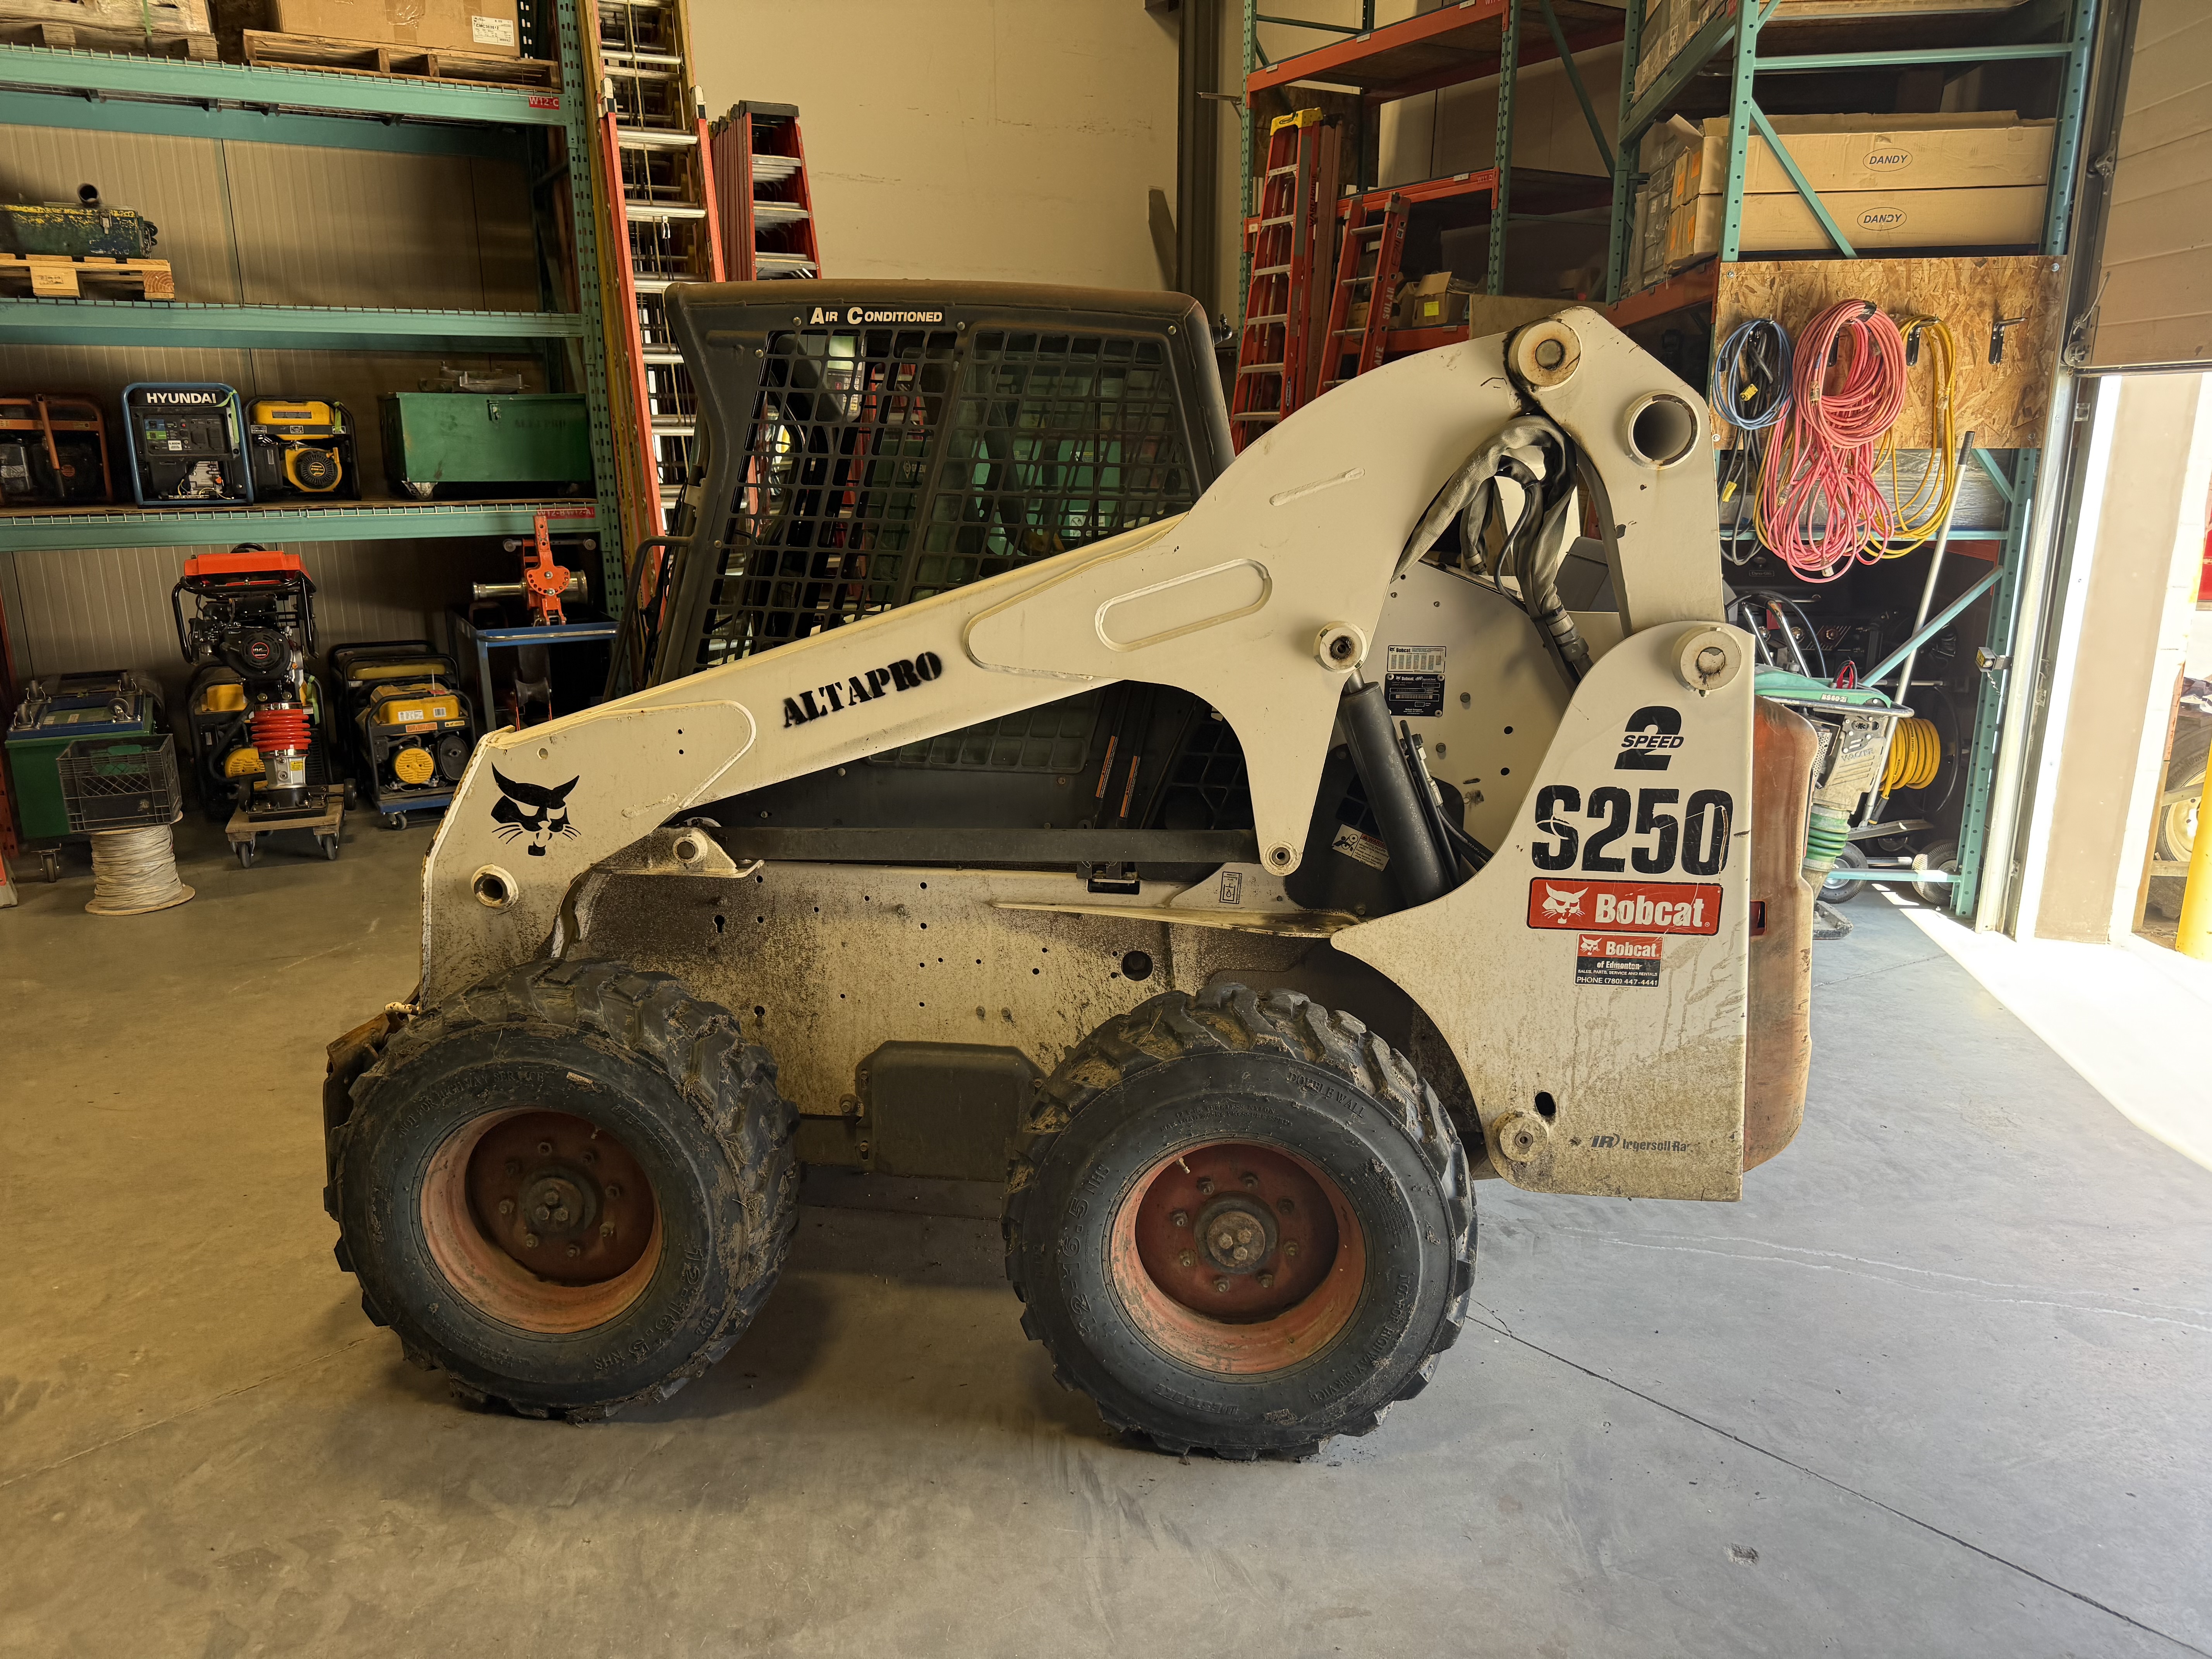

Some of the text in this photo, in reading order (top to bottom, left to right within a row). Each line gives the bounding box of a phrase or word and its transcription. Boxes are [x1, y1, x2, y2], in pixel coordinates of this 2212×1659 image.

[529, 97, 559, 106] W12-C
[1869, 155, 1908, 164] DANDY
[1863, 214, 1902, 223] DANDY
[1382, 287, 1394, 320] SOLAR
[810, 307, 943, 325] AIR CONDITIONED
[146, 393, 217, 404] HYUNDAI
[783, 651, 942, 728] ALTAPRO
[1614, 705, 1682, 771] 2
[1621, 735, 1684, 749] SPEED
[1532, 785, 1733, 876] S250
[1369, 837, 1386, 848] WARN
[1595, 893, 1704, 927] Bobcat
[1606, 941, 1657, 957] Bobcat
[1606, 961, 1640, 970] Edmonton
[1285, 1071, 1366, 1119] DOUBLE WALL
[1085, 1163, 1110, 1195] NHS
[1355, 1325, 1395, 1374] HIGHWAY
[594, 1349, 626, 1370] NHS
